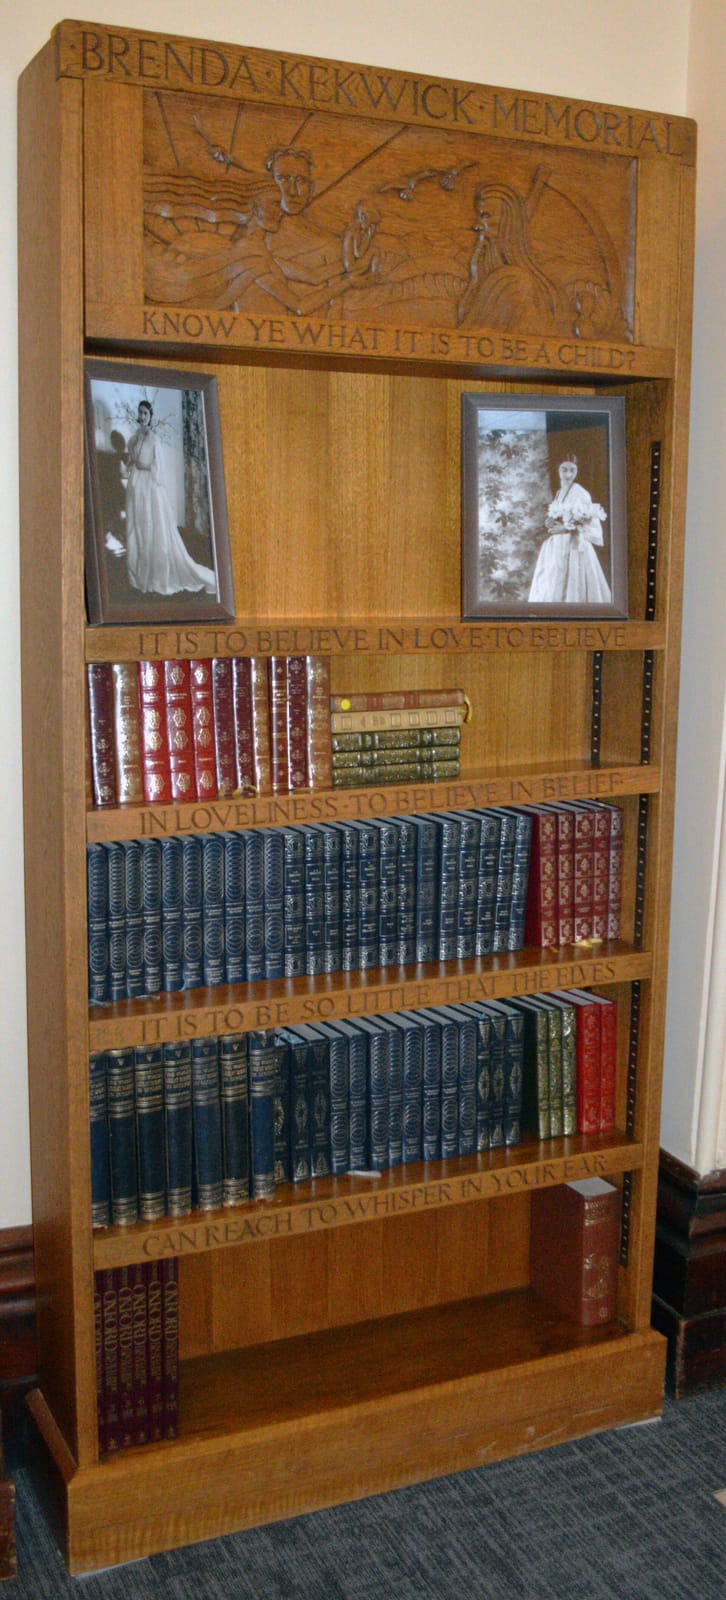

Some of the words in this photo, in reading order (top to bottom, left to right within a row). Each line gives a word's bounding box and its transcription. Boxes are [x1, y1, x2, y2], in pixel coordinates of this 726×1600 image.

[81, 31, 258, 93] BRENDA
[278, 59, 476, 125] KEKWICK
[493, 94, 682, 156] MEMORIAL
[142, 311, 237, 338] KNOW
[247, 318, 285, 343] YE
[291, 321, 384, 350] WHAT
[394, 329, 423, 353] IT
[431, 332, 450, 355] IS
[459, 335, 495, 358] TO
[500, 338, 529, 361] BE
[533, 343, 550, 364] A
[557, 344, 636, 370] CHILD?
[138, 632, 167, 656] IT
[176, 631, 199, 655] IS
[204, 631, 248, 654] TO
[256, 628, 369, 653] BELIEVE
[378, 628, 405, 650] IN
[413, 627, 483, 649] LOVE
[490, 627, 525, 648] TO
[530, 626, 627, 648] BELIEVE
[139, 810, 167, 835] IN
[174, 796, 338, 831] LOVELINESS
[351, 792, 387, 815] TO
[393, 782, 497, 811] BELIEVE
[509, 781, 533, 800] IN
[140, 1016, 168, 1042] IT
[176, 1013, 198, 1036] IS
[205, 1008, 244, 1032] TO
[255, 1002, 289, 1026] BE
[303, 998, 335, 1018] SO
[347, 985, 430, 1014] LITTLE
[436, 975, 503, 1001] THAT
[511, 970, 551, 991] THE
[557, 961, 616, 987] ELVES
[142, 1230, 198, 1257] CAN
[204, 1212, 292, 1247] REACH
[300, 1204, 337, 1230] TO
[342, 1183, 451, 1217] WHISPER
[460, 1178, 483, 1197] IN
[491, 1163, 555, 1190] YOUR
